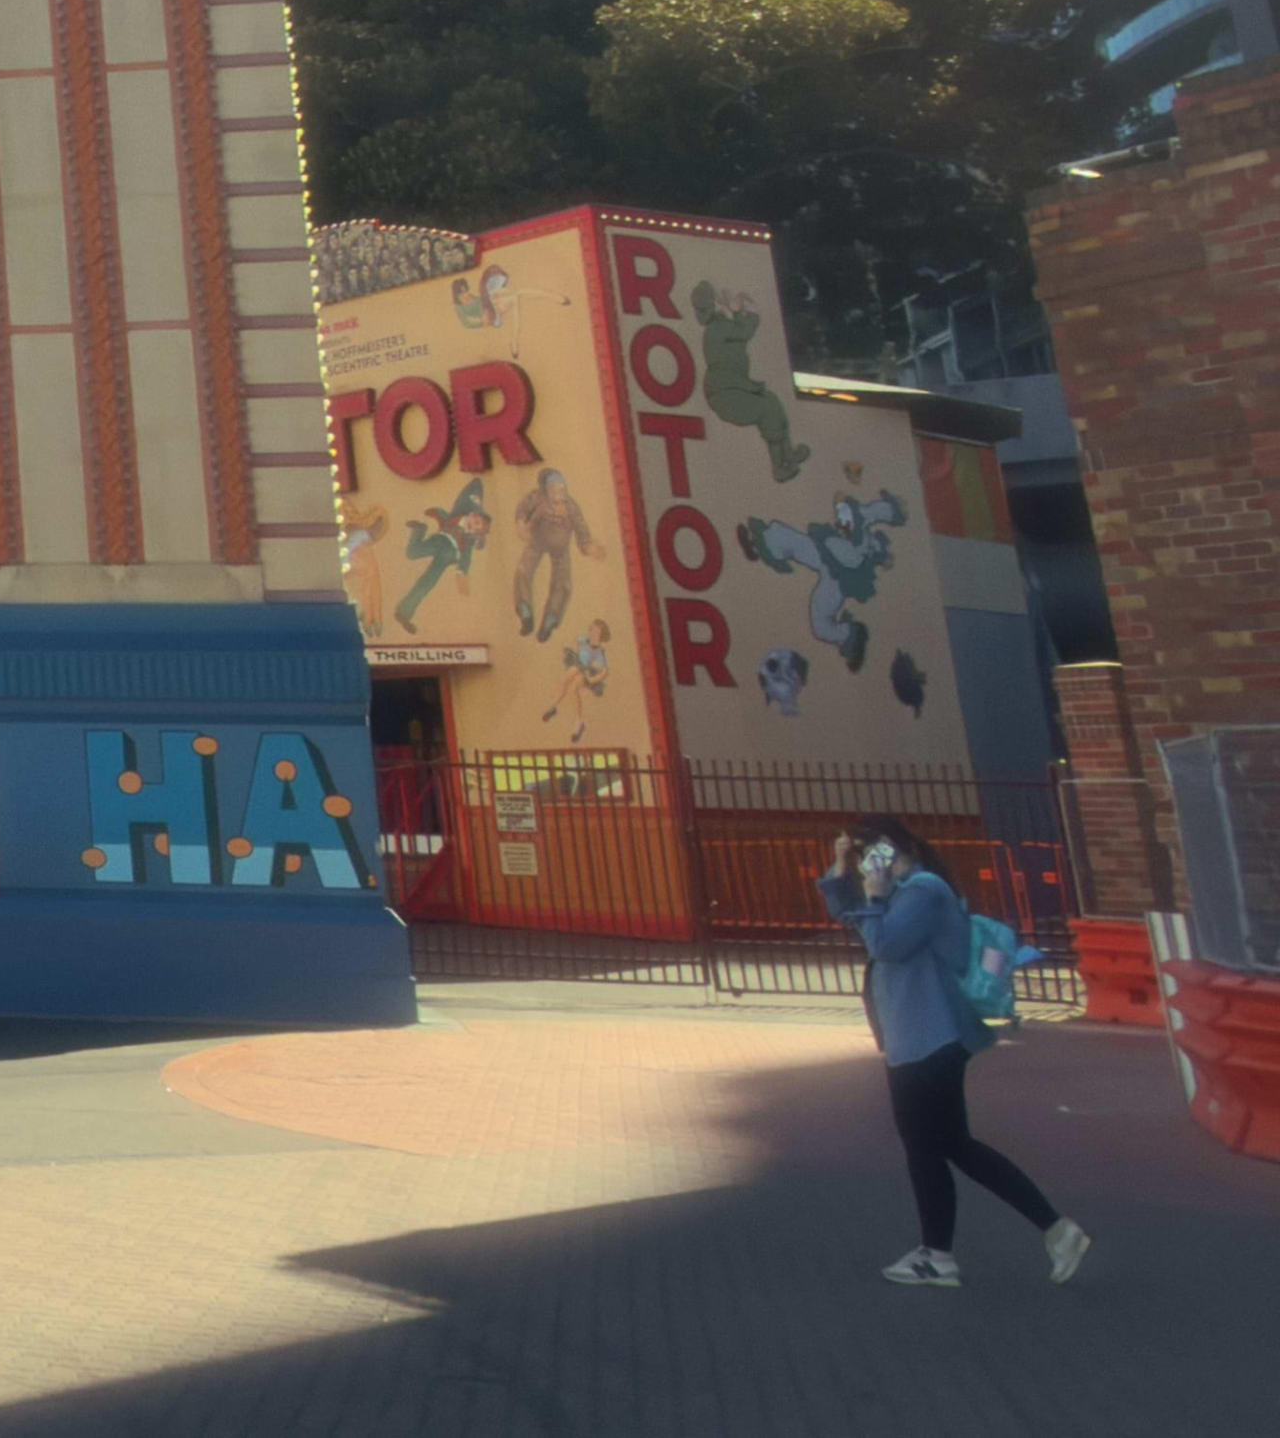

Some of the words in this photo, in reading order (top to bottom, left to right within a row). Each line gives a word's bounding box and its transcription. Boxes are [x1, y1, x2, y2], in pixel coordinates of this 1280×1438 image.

[328, 354, 382, 377] SCIENTIFIC
[384, 343, 430, 362] THEATRE
[611, 233, 739, 689] ROTOR
[374, 649, 467, 661] THRILLING
[84, 728, 378, 890] HA
